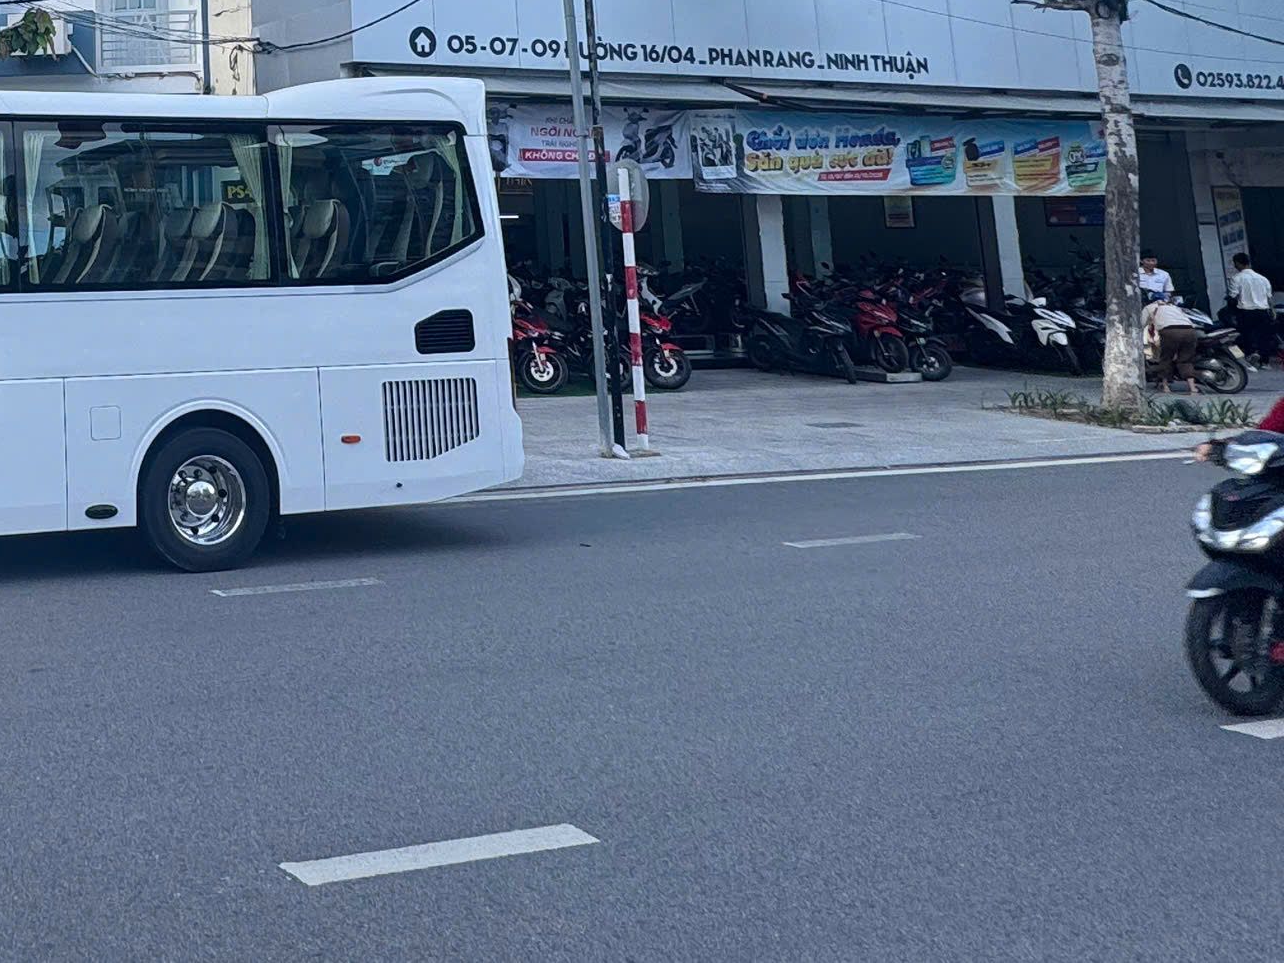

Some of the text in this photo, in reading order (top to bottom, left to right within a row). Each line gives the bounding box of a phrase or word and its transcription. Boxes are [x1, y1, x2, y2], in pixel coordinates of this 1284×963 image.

[641, 43, 696, 65] 16/04
[707, 47, 761, 67] PHAN
[766, 48, 815, 69] RANG
[826, 52, 869, 71] NINH
[870, 50, 930, 80] THUẬN
[524, 149, 564, 160] KHÔNG
